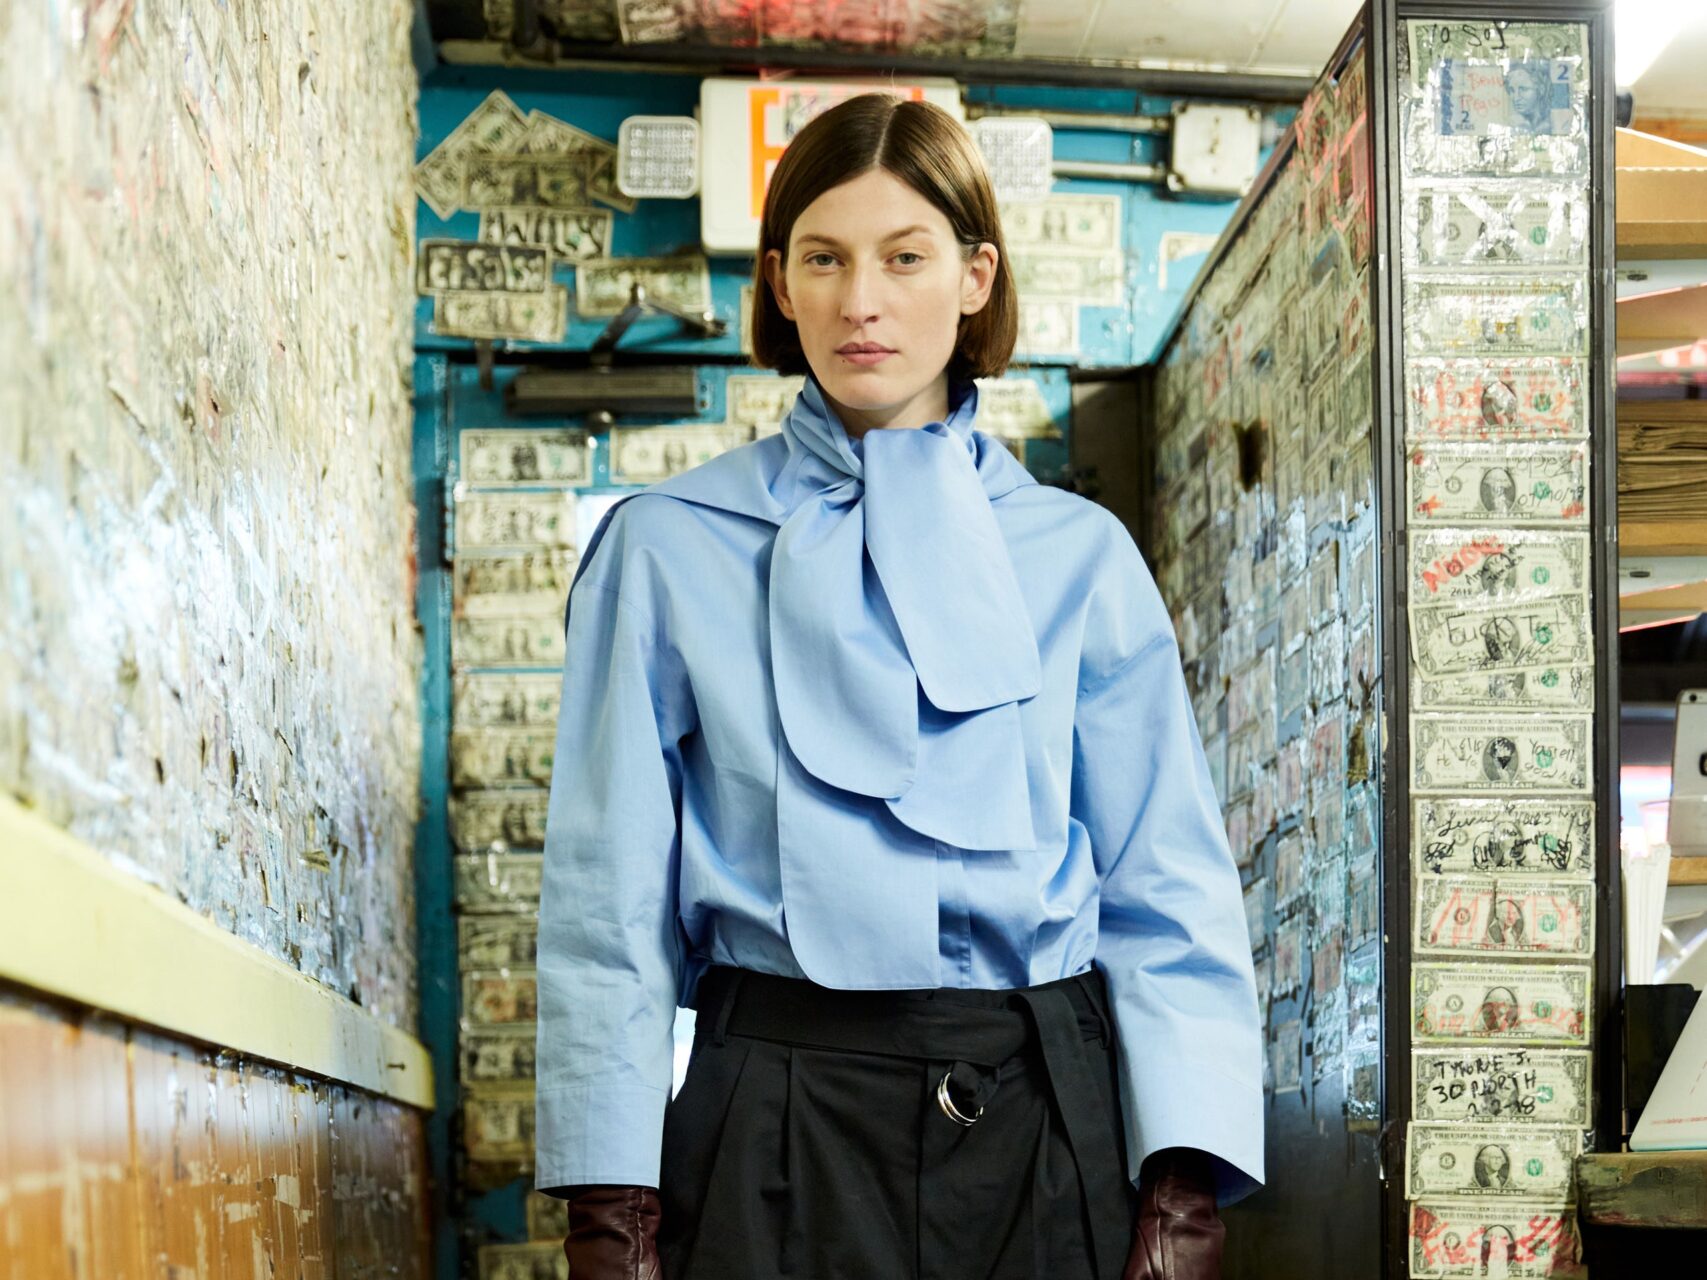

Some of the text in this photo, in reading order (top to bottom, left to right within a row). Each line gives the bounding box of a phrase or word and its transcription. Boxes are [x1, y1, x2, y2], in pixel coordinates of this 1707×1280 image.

[1557, 64, 1569, 81] 2
[1461, 111, 1470, 123] 2
[1432, 1069, 1537, 1104] 30 NORTH
[1483, 1188, 1525, 1196] DOLLAR
